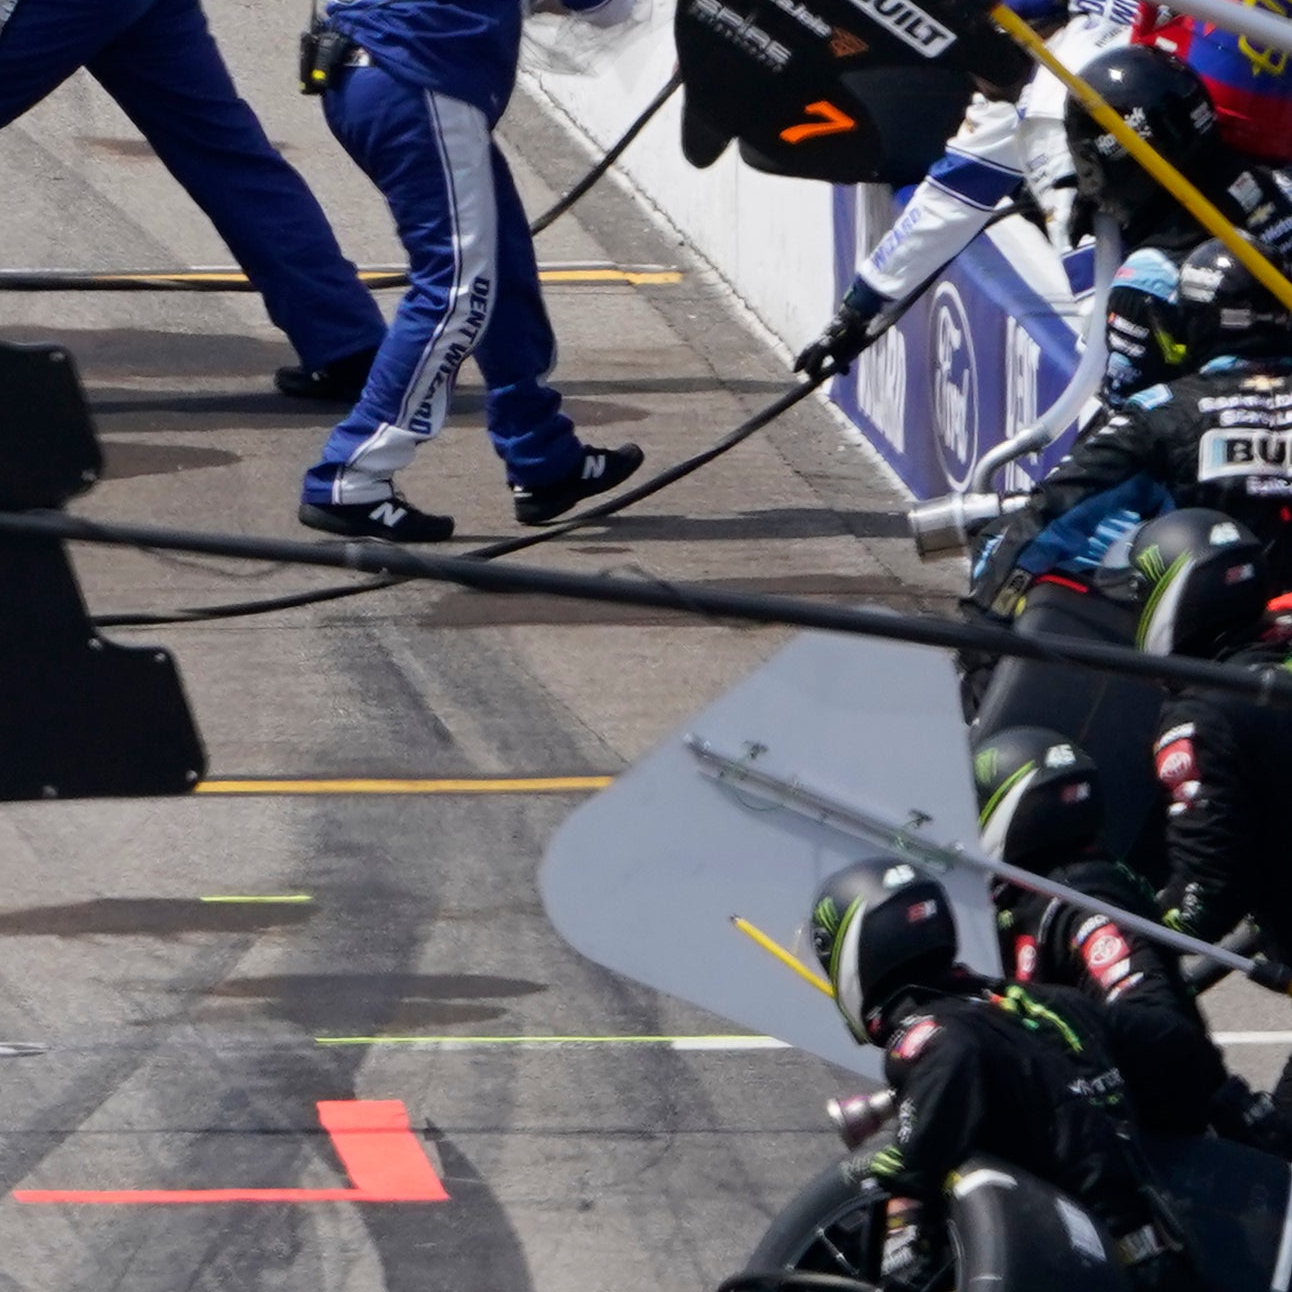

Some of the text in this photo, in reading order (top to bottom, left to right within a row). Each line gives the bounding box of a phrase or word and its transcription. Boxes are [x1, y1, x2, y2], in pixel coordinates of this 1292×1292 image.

[779, 100, 856, 145] 7
[408, 275, 489, 436] DENT WIZARD
[581, 454, 606, 480] N
[369, 501, 409, 529] N
